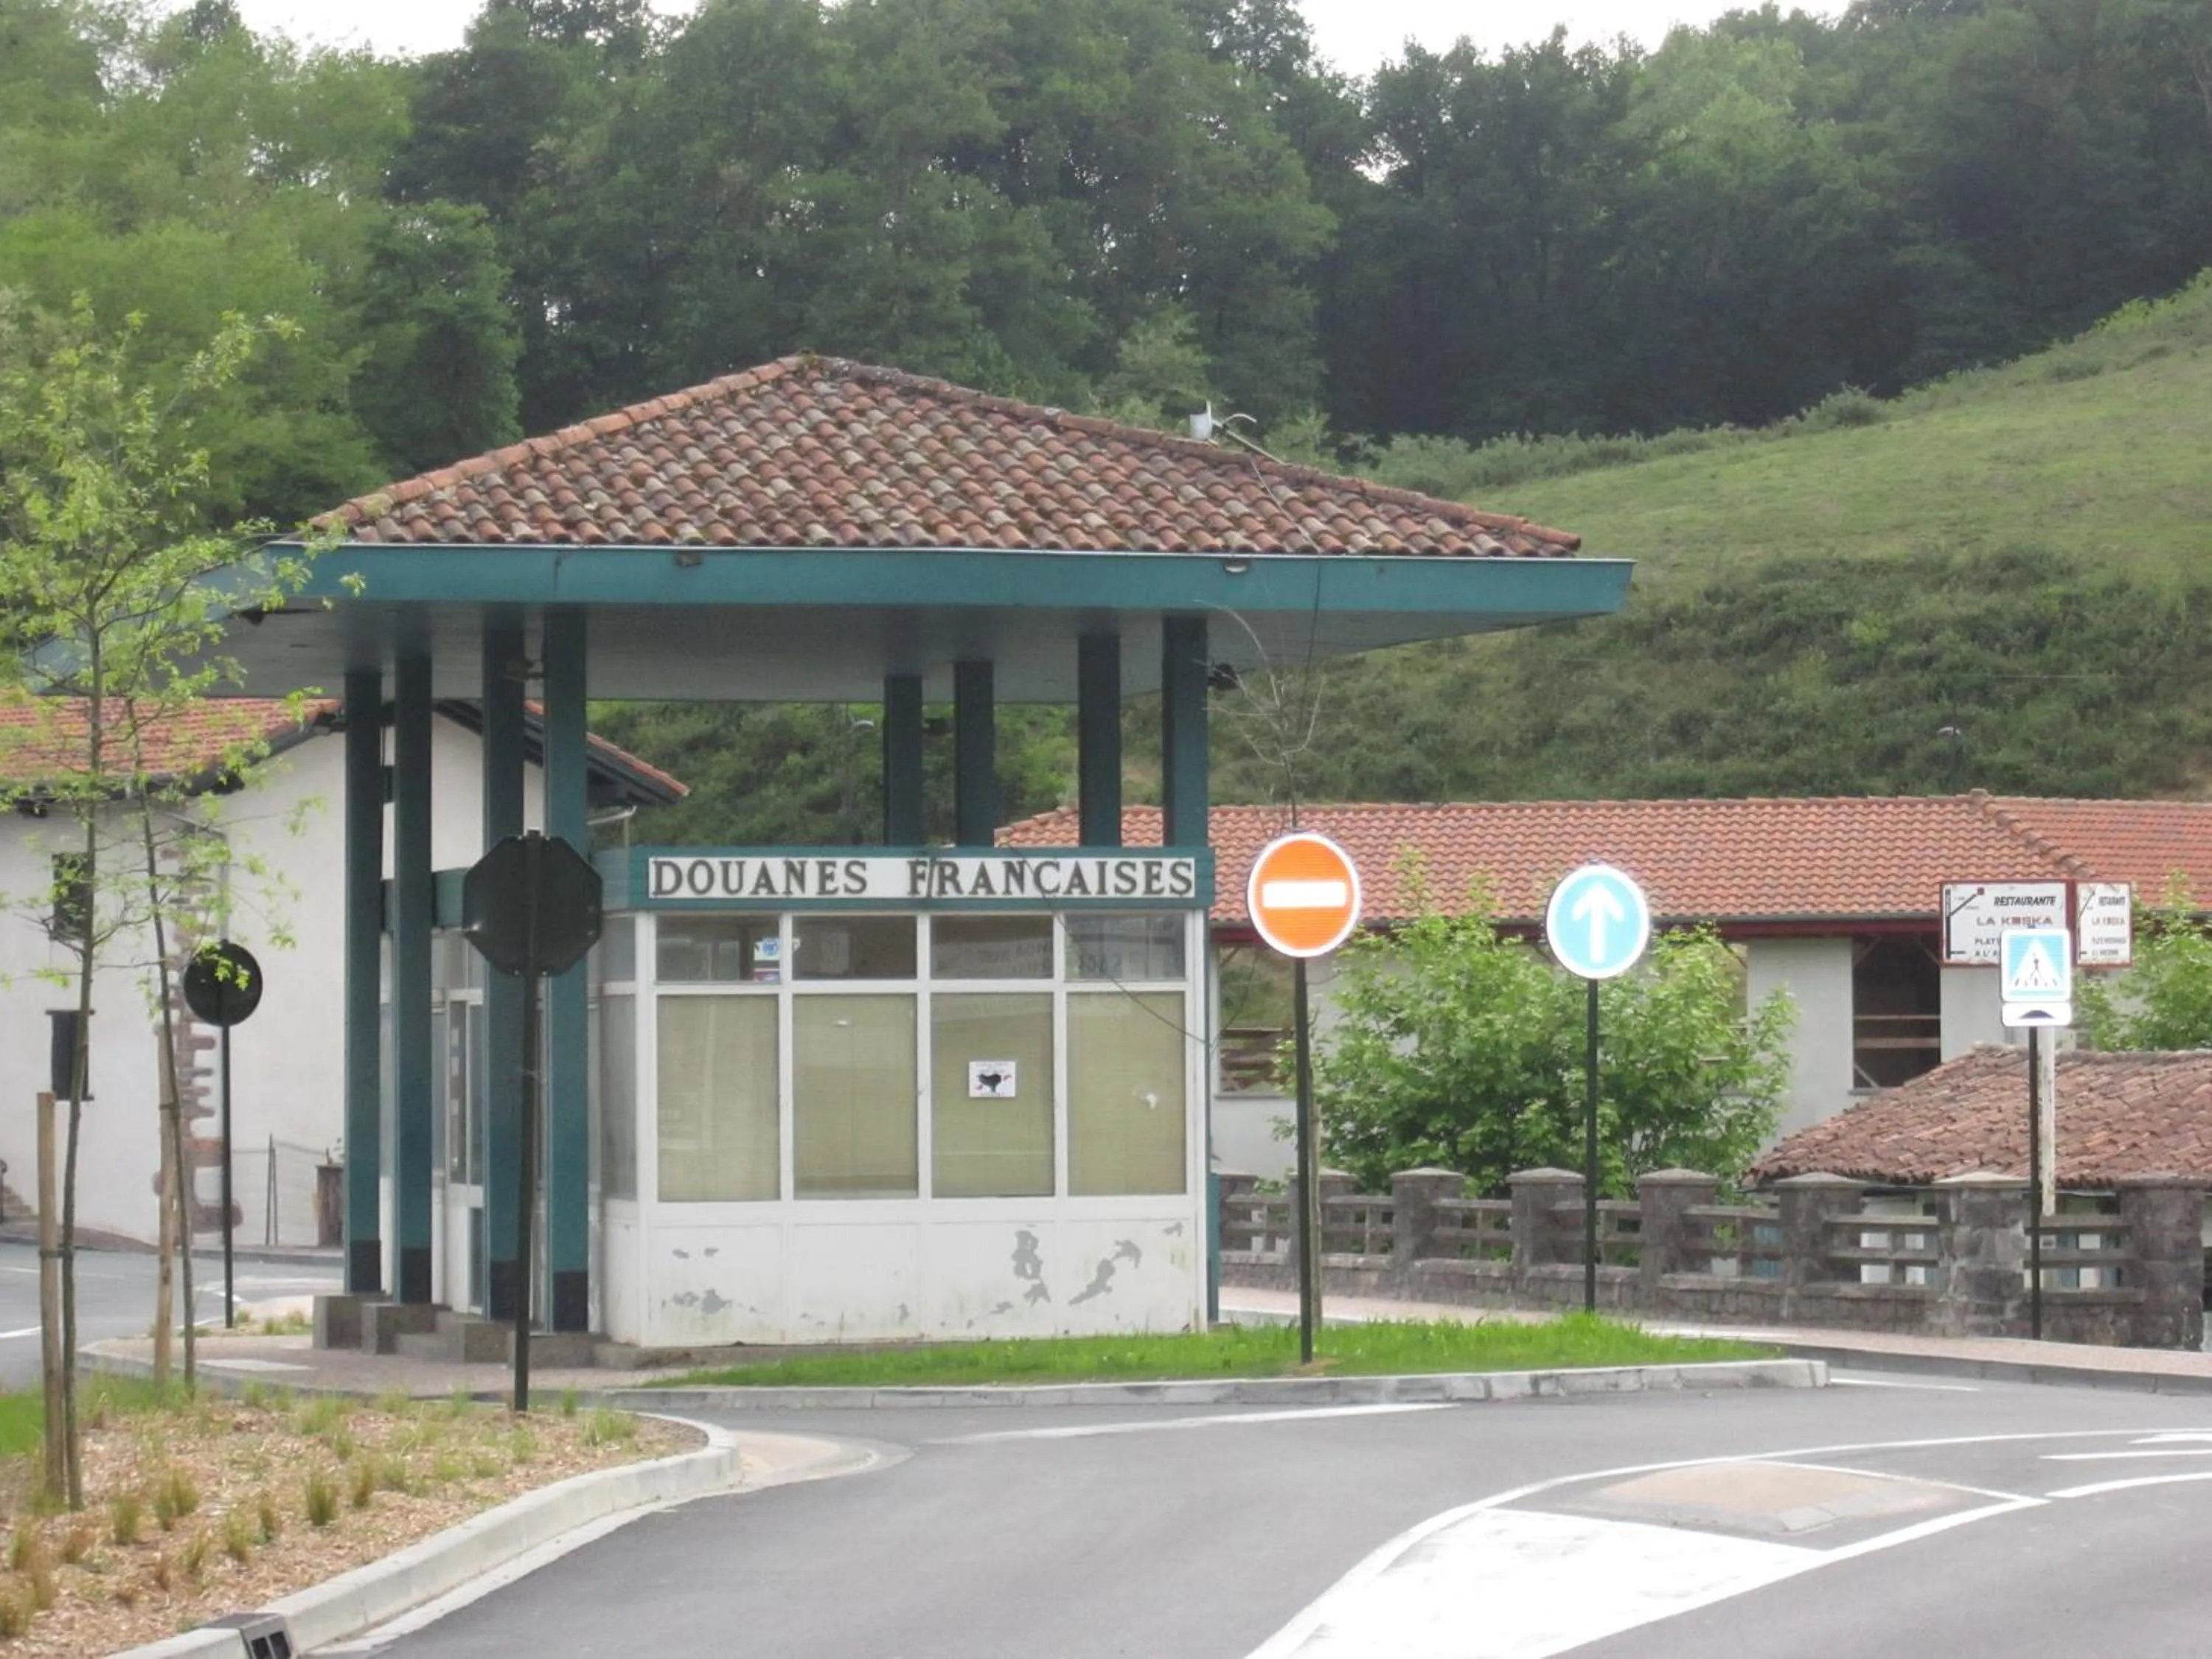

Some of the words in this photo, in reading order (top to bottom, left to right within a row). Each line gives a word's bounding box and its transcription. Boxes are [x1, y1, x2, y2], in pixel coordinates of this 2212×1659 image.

[652, 860, 868, 896] DOUANES
[1994, 896, 2056, 906] RESTAURANTE
[1976, 917, 1995, 926] LA
